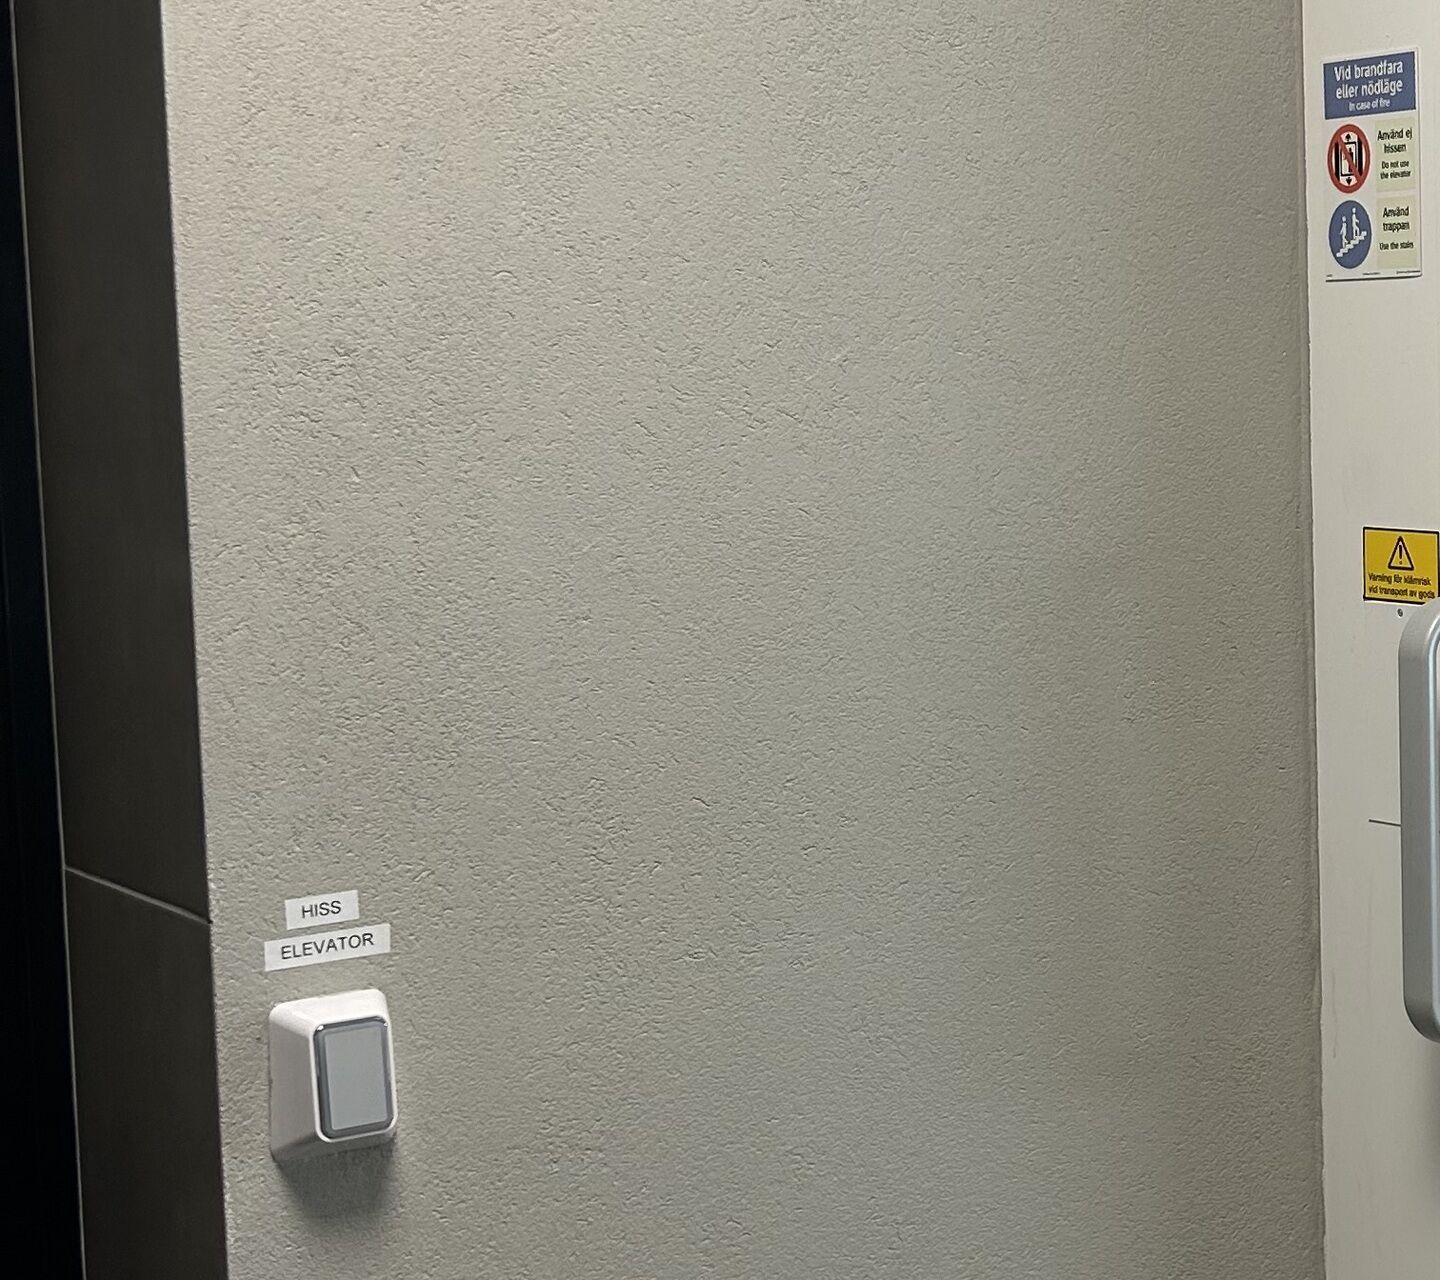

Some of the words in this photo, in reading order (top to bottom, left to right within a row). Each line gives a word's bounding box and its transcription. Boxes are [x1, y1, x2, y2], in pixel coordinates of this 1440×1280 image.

[1334, 65, 1351, 81] Vid
[1354, 60, 1404, 79] brandfara
[1336, 84, 1359, 99] eller
[1361, 79, 1403, 96] nödläge
[1349, 102, 1355, 111] In
[1356, 100, 1370, 111] case
[1371, 98, 1378, 108] of
[1379, 98, 1390, 108] fire
[1377, 128, 1403, 140] Använd
[1405, 127, 1412, 140] ej
[1382, 161, 1389, 169] Do
[1383, 206, 1409, 218] Använd
[1368, 573, 1392, 585] Varning
[1393, 574, 1402, 583] för
[1368, 585, 1378, 593] vid
[301, 900, 341, 918] HISS
[281, 932, 374, 960] ELEVATOR
